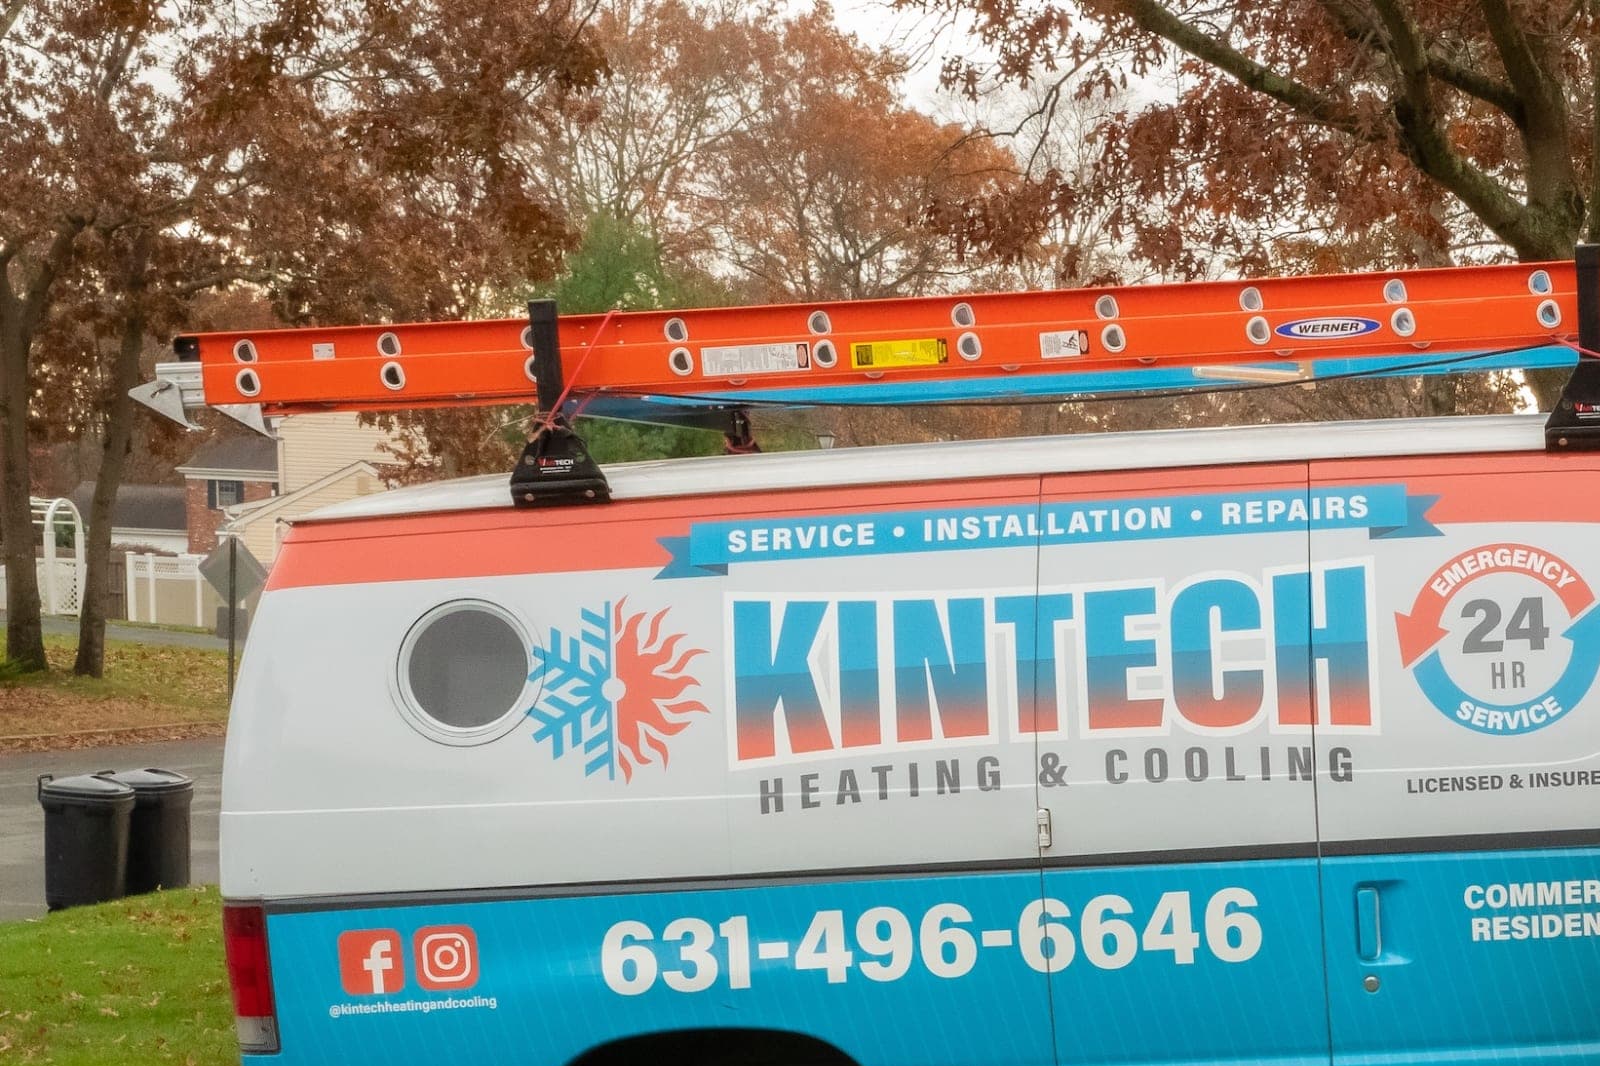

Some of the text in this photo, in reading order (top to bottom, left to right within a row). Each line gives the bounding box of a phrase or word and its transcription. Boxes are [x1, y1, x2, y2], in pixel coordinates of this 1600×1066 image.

[1299, 322, 1359, 333] WERNER
[727, 495, 1369, 554] SERVICE INSTALLATION REPAIRS
[1430, 548, 1576, 597] EMERGENCY
[1460, 597, 1550, 654] 24
[730, 561, 1374, 762] KINTECH
[1490, 660, 1526, 690] HR
[1456, 695, 1563, 730] SERVICE
[758, 745, 1354, 815] HEATING & COOLING
[1406, 775, 1503, 794] LICENSED
[1509, 773, 1524, 789] &
[601, 887, 1263, 996] 631-496-6646
[328, 994, 498, 1018] @kintechheatingandcooling
